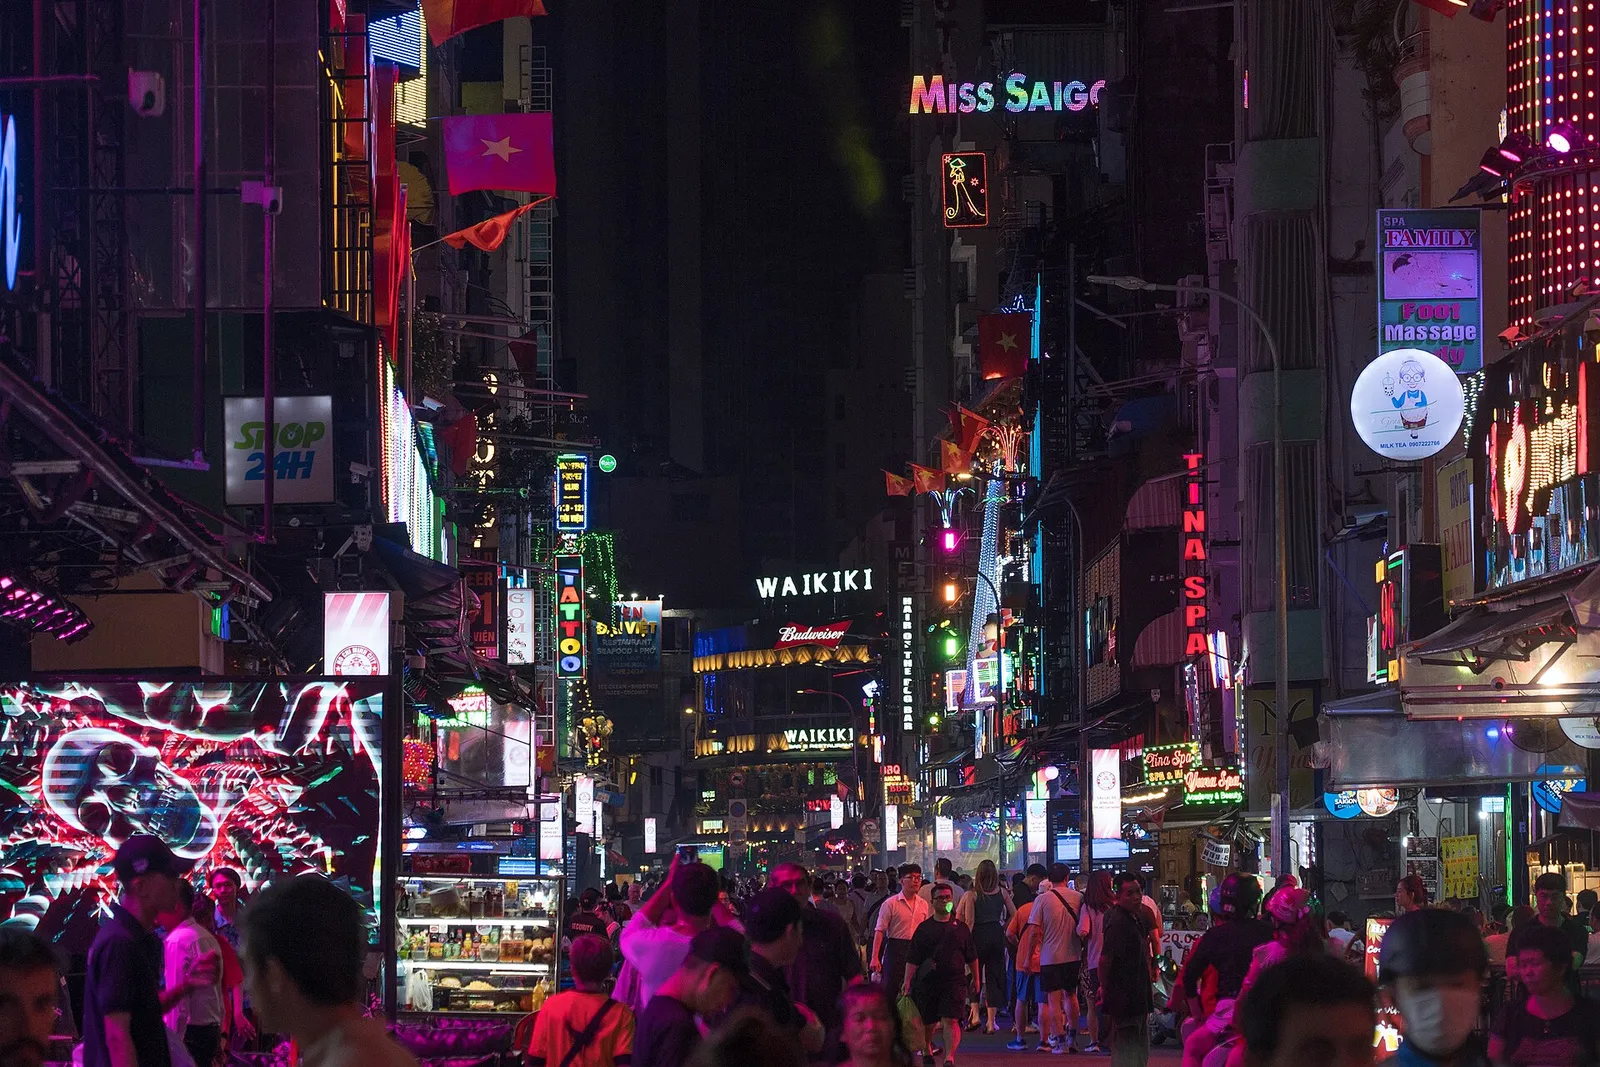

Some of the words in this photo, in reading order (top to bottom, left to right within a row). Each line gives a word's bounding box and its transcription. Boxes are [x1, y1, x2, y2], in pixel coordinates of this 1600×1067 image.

[909, 74, 995, 114] MISS
[1384, 217, 1406, 226] SPA
[1384, 228, 1477, 248] FAMILY
[1384, 324, 1477, 342] Massage
[244, 452, 316, 481] 24H
[1183, 454, 1206, 560] TINA
[756, 568, 872, 598] WAIKIKI
[558, 568, 581, 672] TATTOO
[902, 597, 912, 629] HAIR
[1184, 576, 1207, 656] SPA
[473, 630, 495, 643] VIỆN
[624, 618, 657, 636] VIỆT
[779, 626, 845, 642] Budweiser
[903, 651, 913, 675] THE
[903, 706, 913, 730] BAR
[784, 728, 853, 742] WAIKIKI
[1146, 752, 1171, 768] Tina
[1171, 750, 1192, 768] Spa
[1218, 770, 1241, 790] Spa
